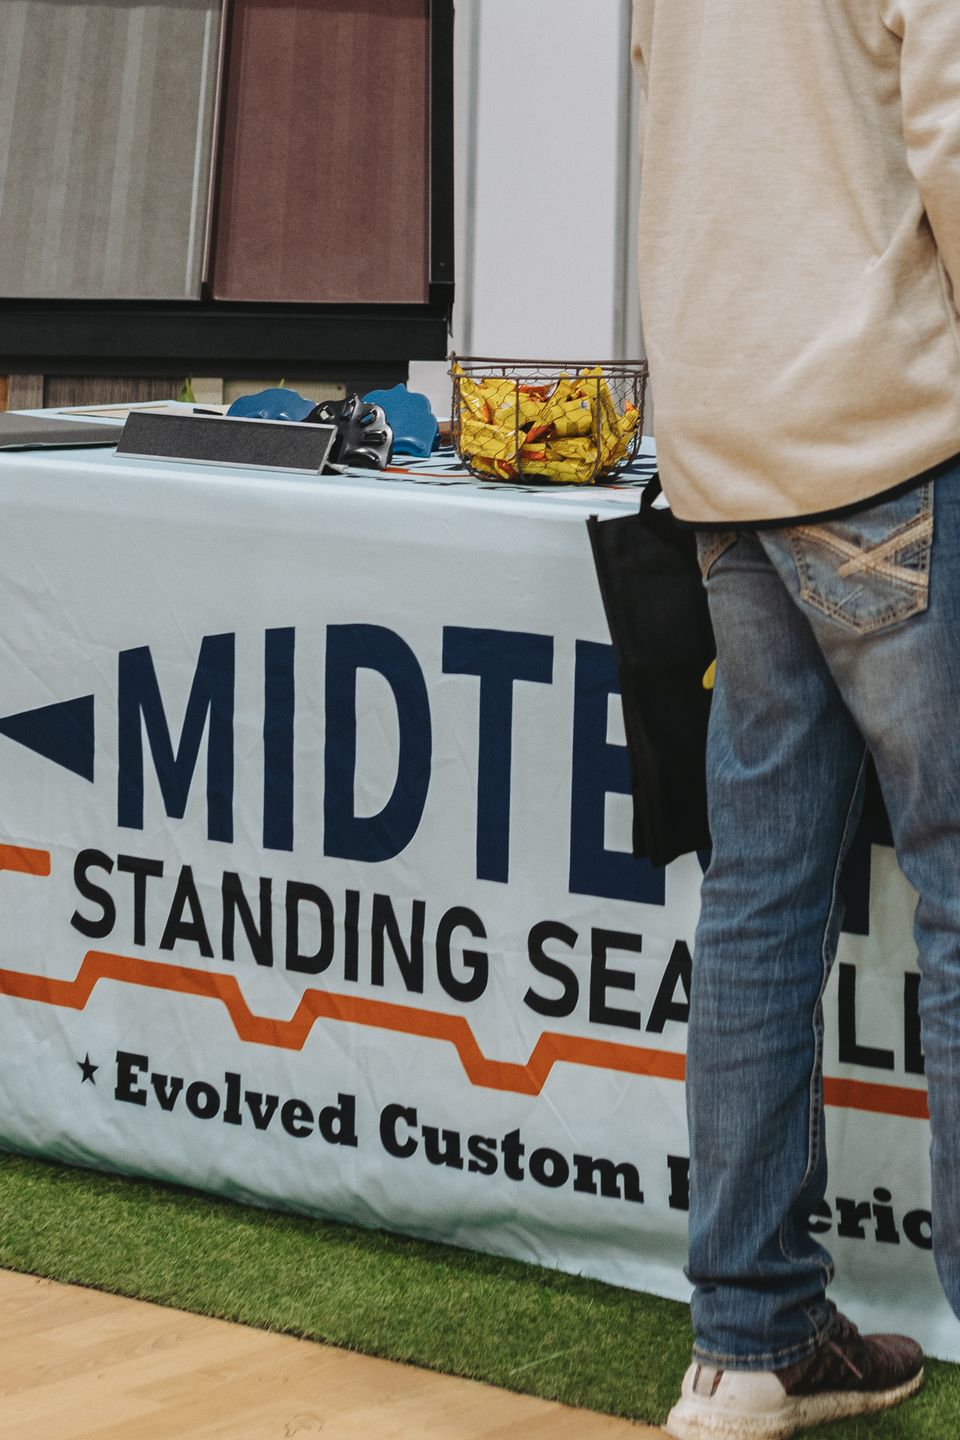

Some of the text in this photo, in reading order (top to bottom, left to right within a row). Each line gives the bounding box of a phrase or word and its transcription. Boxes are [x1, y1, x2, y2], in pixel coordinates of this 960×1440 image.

[117, 623, 896, 935] MIDTE
[70, 848, 489, 1003] STANDING
[523, 920, 692, 1033] SEA
[115, 1051, 357, 1146] Evolved
[379, 1104, 643, 1203] Custom
